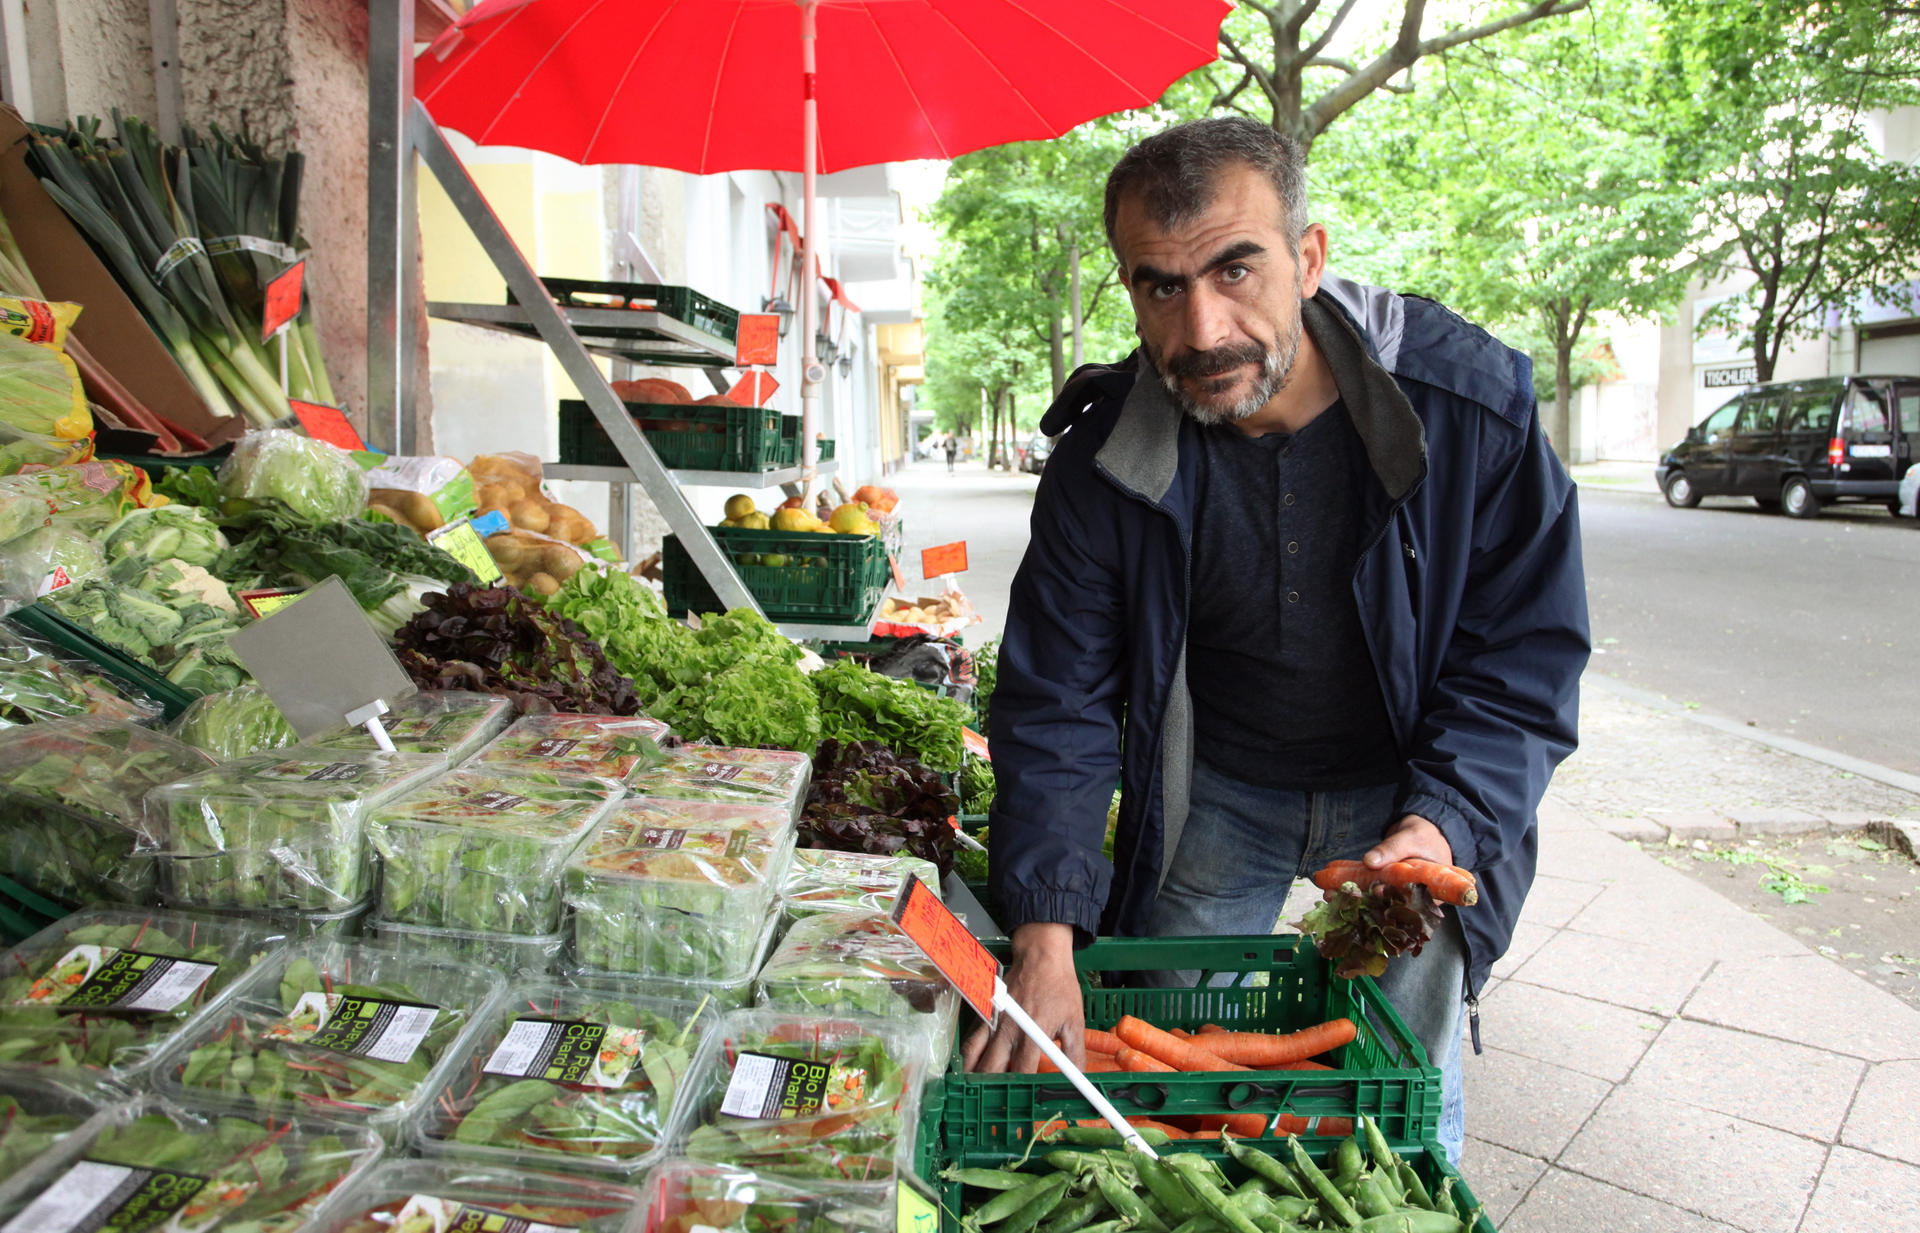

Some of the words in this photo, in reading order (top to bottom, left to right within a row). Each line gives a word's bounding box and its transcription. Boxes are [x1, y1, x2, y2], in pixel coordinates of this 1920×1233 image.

[96, 954, 137, 982] Red
[310, 1033, 338, 1047] Bio
[328, 1000, 361, 1031] Red
[330, 1020, 369, 1050] Chard
[553, 1025, 585, 1066] Chard
[579, 1026, 603, 1051] Bio
[563, 1055, 590, 1081] Red
[806, 1065, 826, 1093] Bio
[784, 1063, 809, 1107] Chard
[800, 1096, 819, 1116] Re
[447, 1208, 486, 1233] ed
